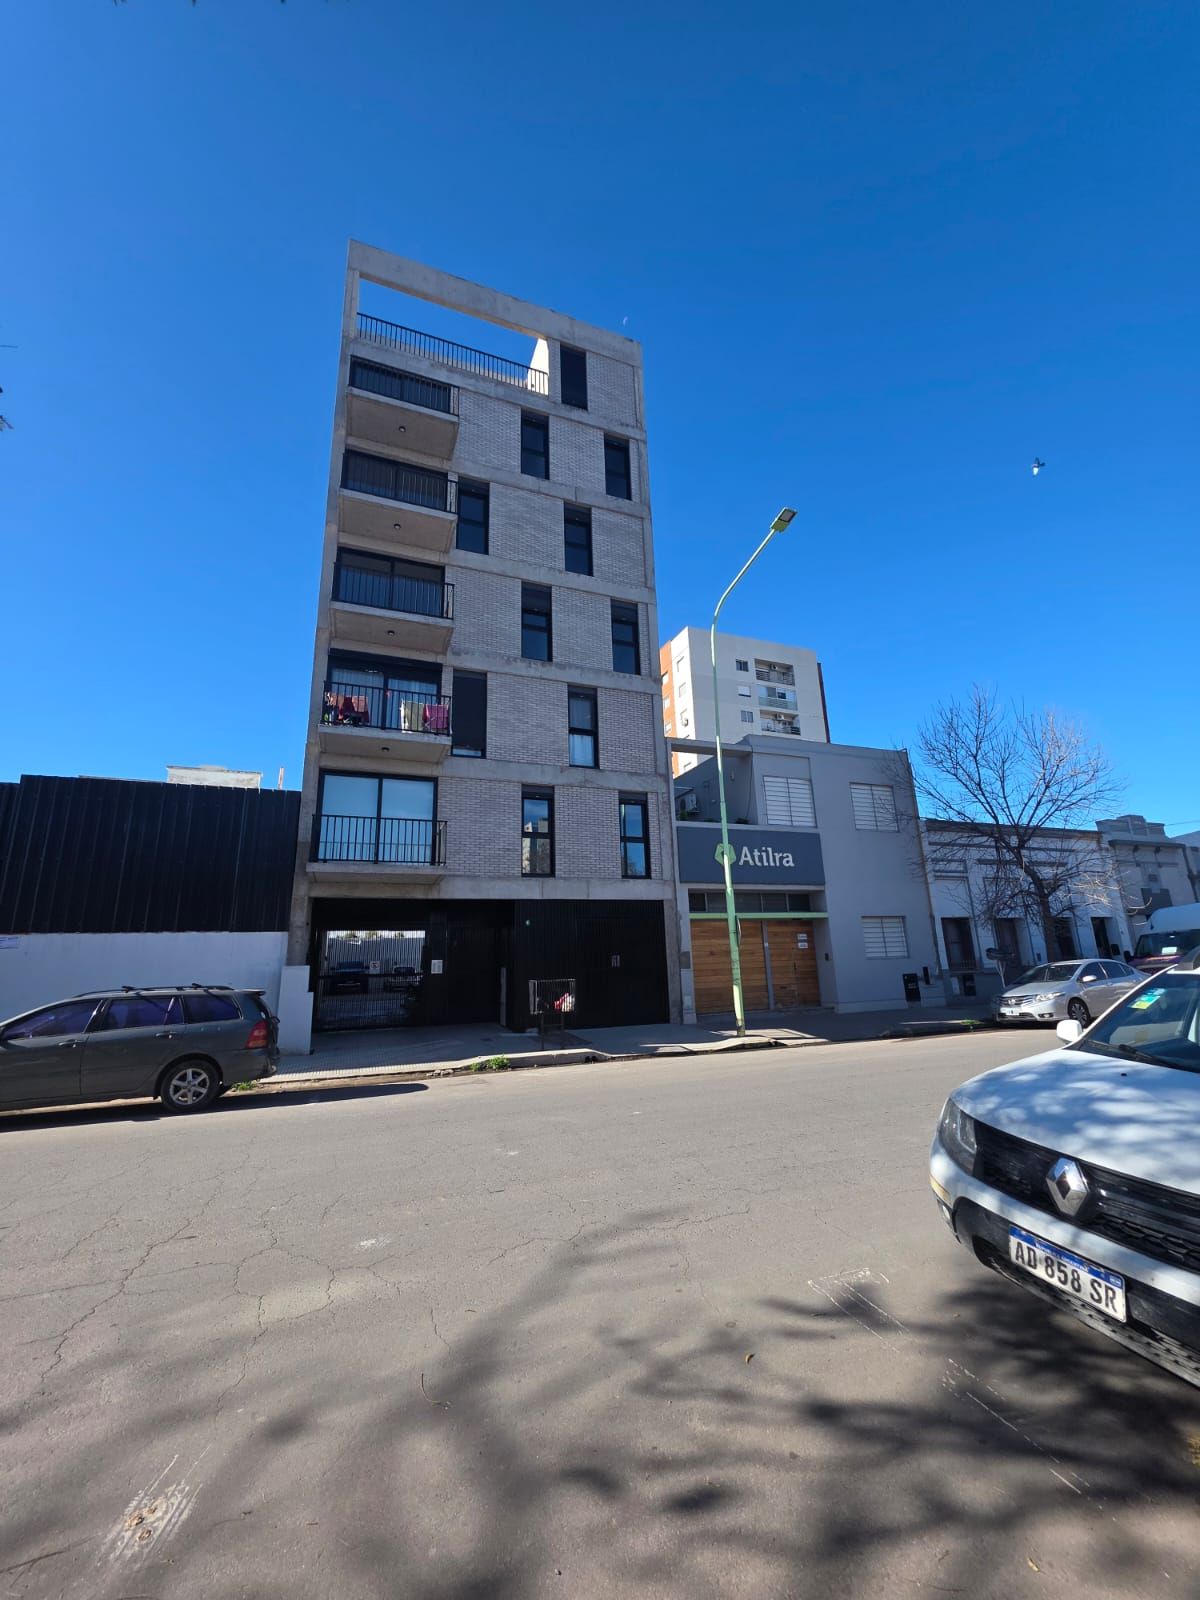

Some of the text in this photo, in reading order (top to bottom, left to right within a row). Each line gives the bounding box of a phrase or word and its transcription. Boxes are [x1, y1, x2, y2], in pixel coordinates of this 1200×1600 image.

[738, 846, 795, 867] Atilra
[1015, 1240, 1037, 1270] AD
[1044, 1255, 1082, 1293] 858
[1090, 1278, 1117, 1313] SR
